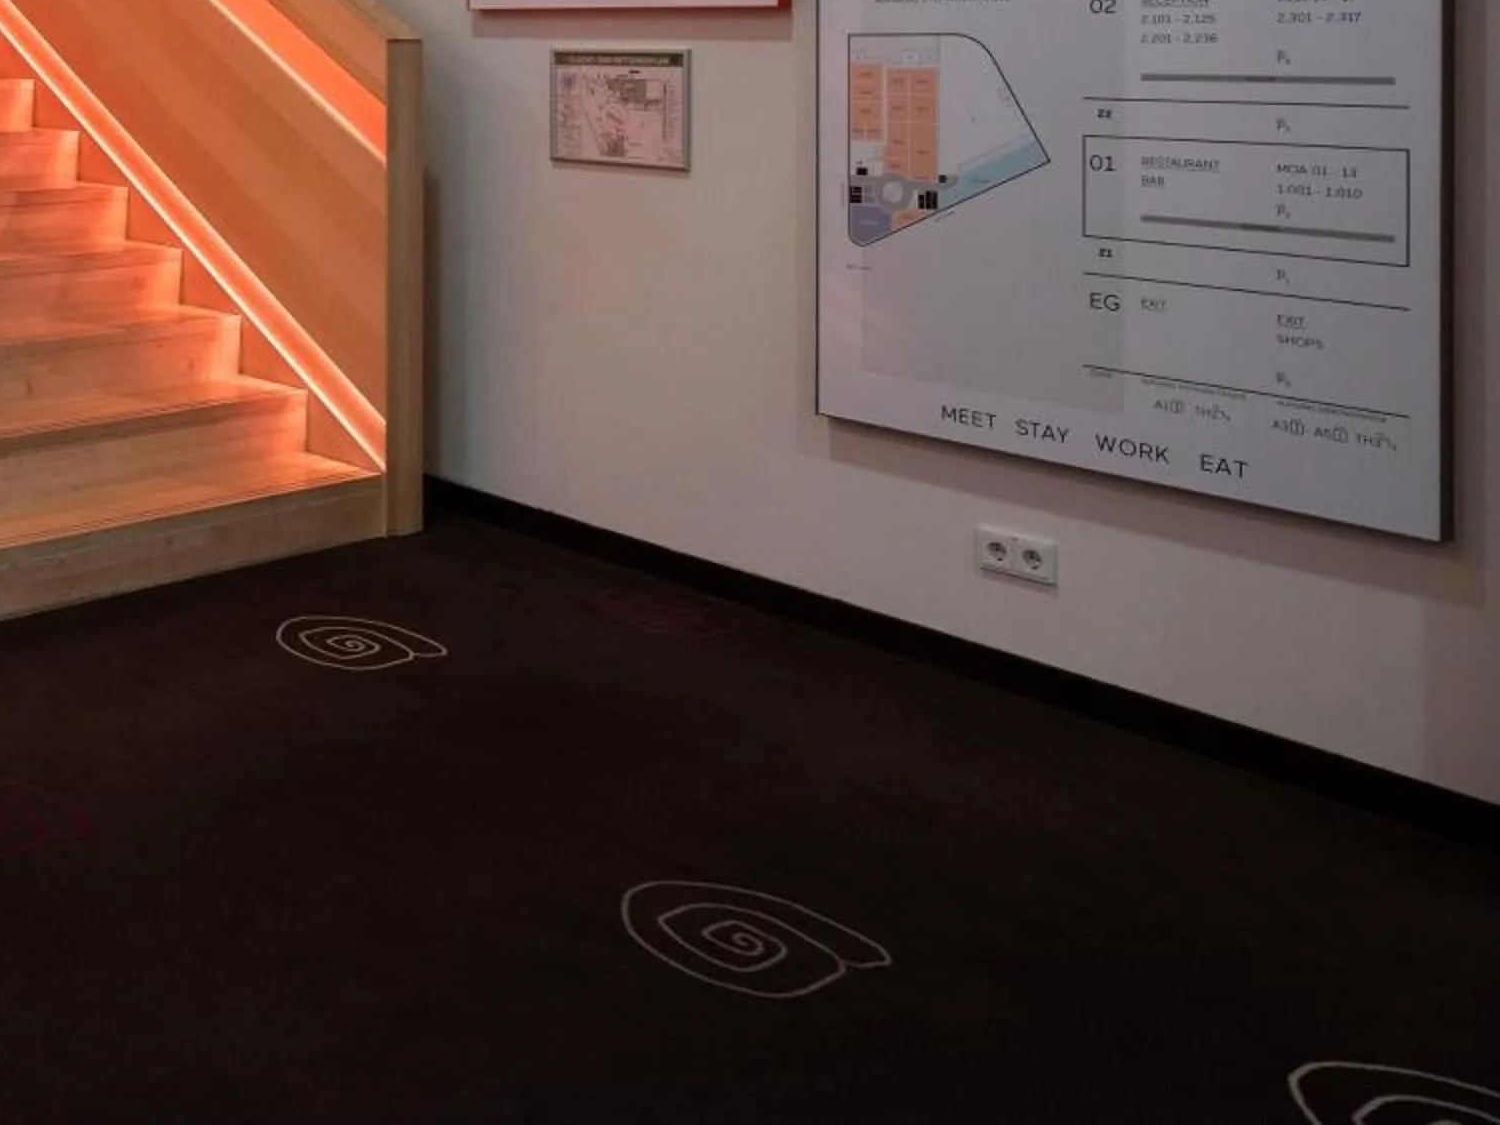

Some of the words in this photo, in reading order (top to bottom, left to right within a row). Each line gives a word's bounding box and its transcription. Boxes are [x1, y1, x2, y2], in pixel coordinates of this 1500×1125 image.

[1089, 154, 1117, 172] 01
[1141, 155, 1222, 173] RESTAURANT
[1277, 163, 1308, 174] MOA
[1141, 175, 1166, 187] BAR
[1089, 292, 1122, 313] EG
[1277, 314, 1306, 330] EXIT
[1277, 334, 1325, 350] SHOPS
[940, 404, 997, 429] MEET
[1014, 418, 1070, 445] STAY
[1096, 433, 1170, 465] WORK
[1200, 453, 1249, 479] EAT
